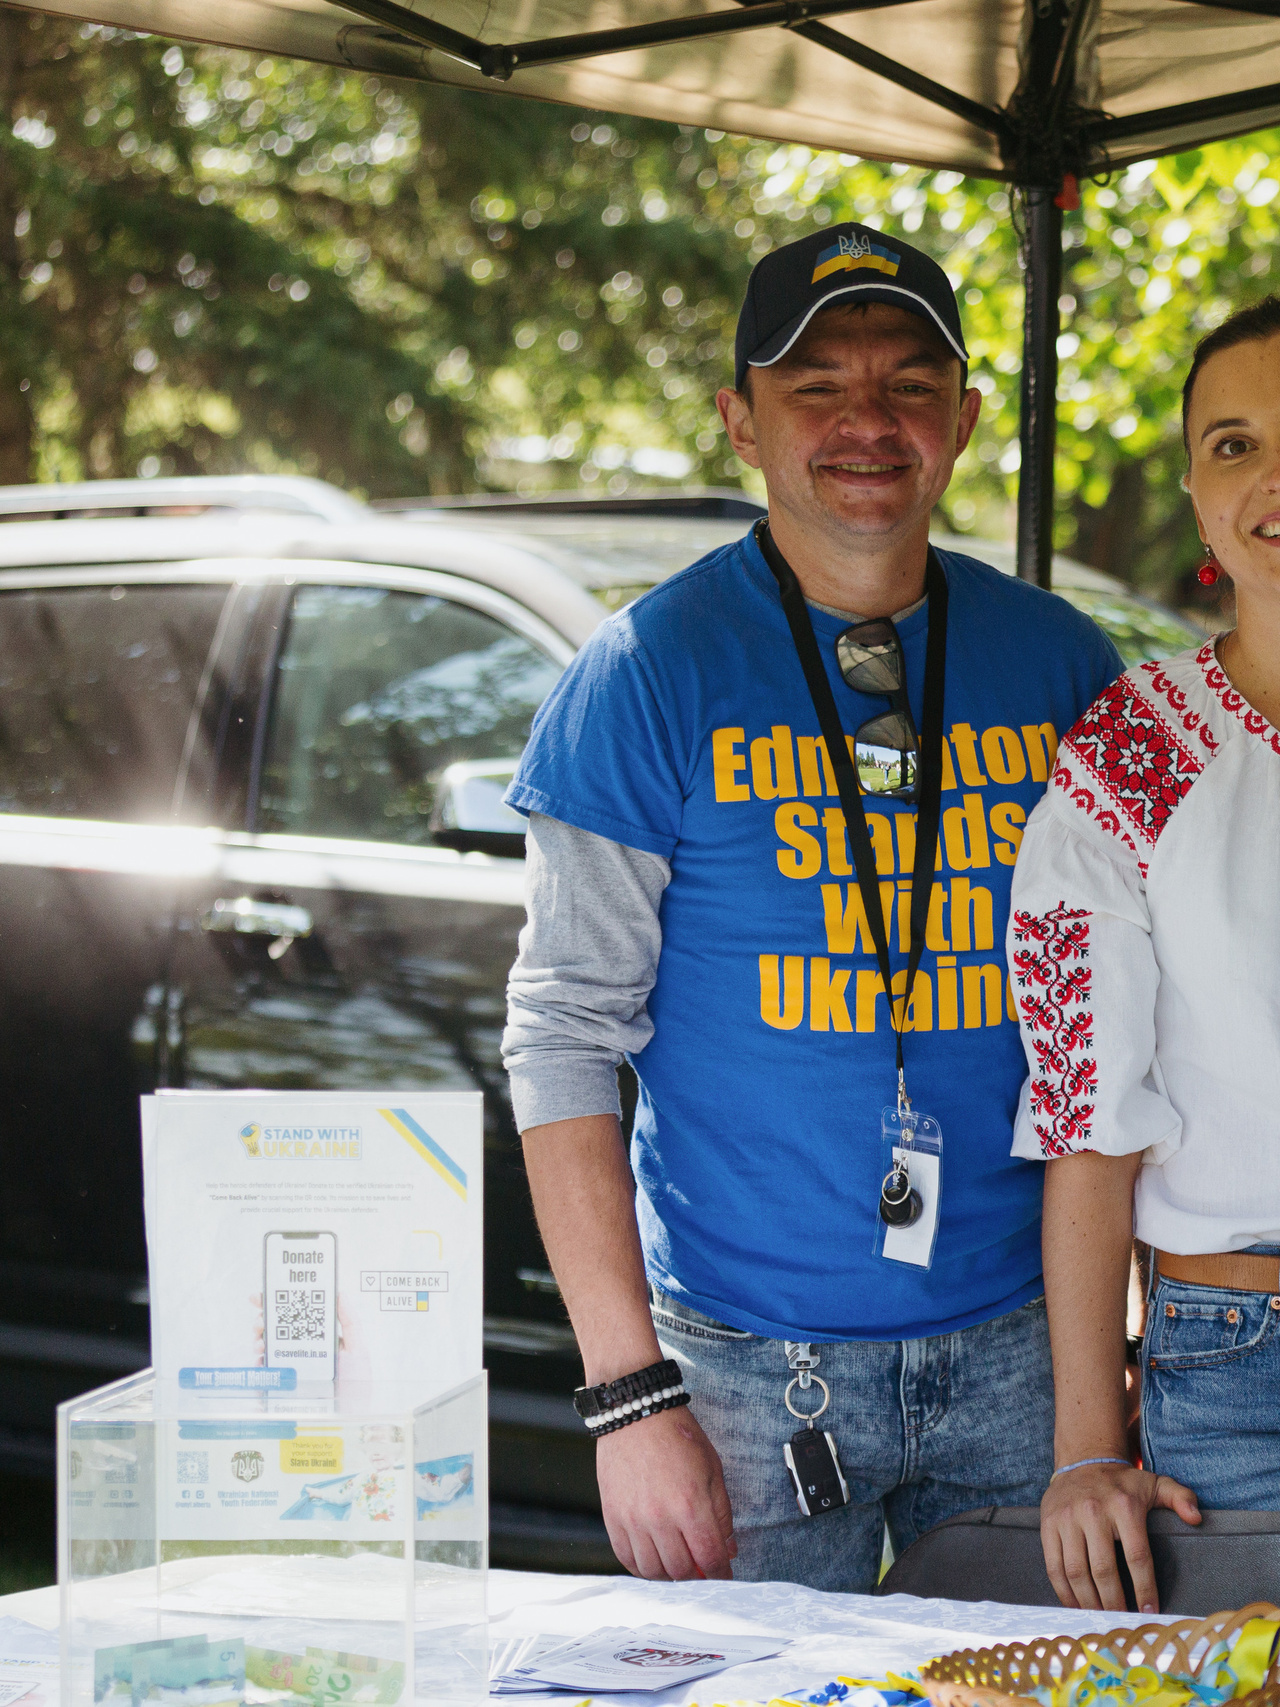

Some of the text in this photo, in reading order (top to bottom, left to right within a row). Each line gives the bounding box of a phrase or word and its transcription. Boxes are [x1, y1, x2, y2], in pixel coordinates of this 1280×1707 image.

[820, 877, 994, 955] With
[758, 954, 1019, 1033] Ukrain
[264, 1128, 360, 1140] STAND WITH
[264, 1141, 360, 1158] UKRAINE
[282, 1250, 324, 1265] Donate
[289, 1269, 317, 1284] here
[386, 1276, 441, 1288] COME BACK
[386, 1296, 413, 1307] ALIVE
[290, 1458, 310, 1467] Slava
[220, 1651, 235, 1662] 5
